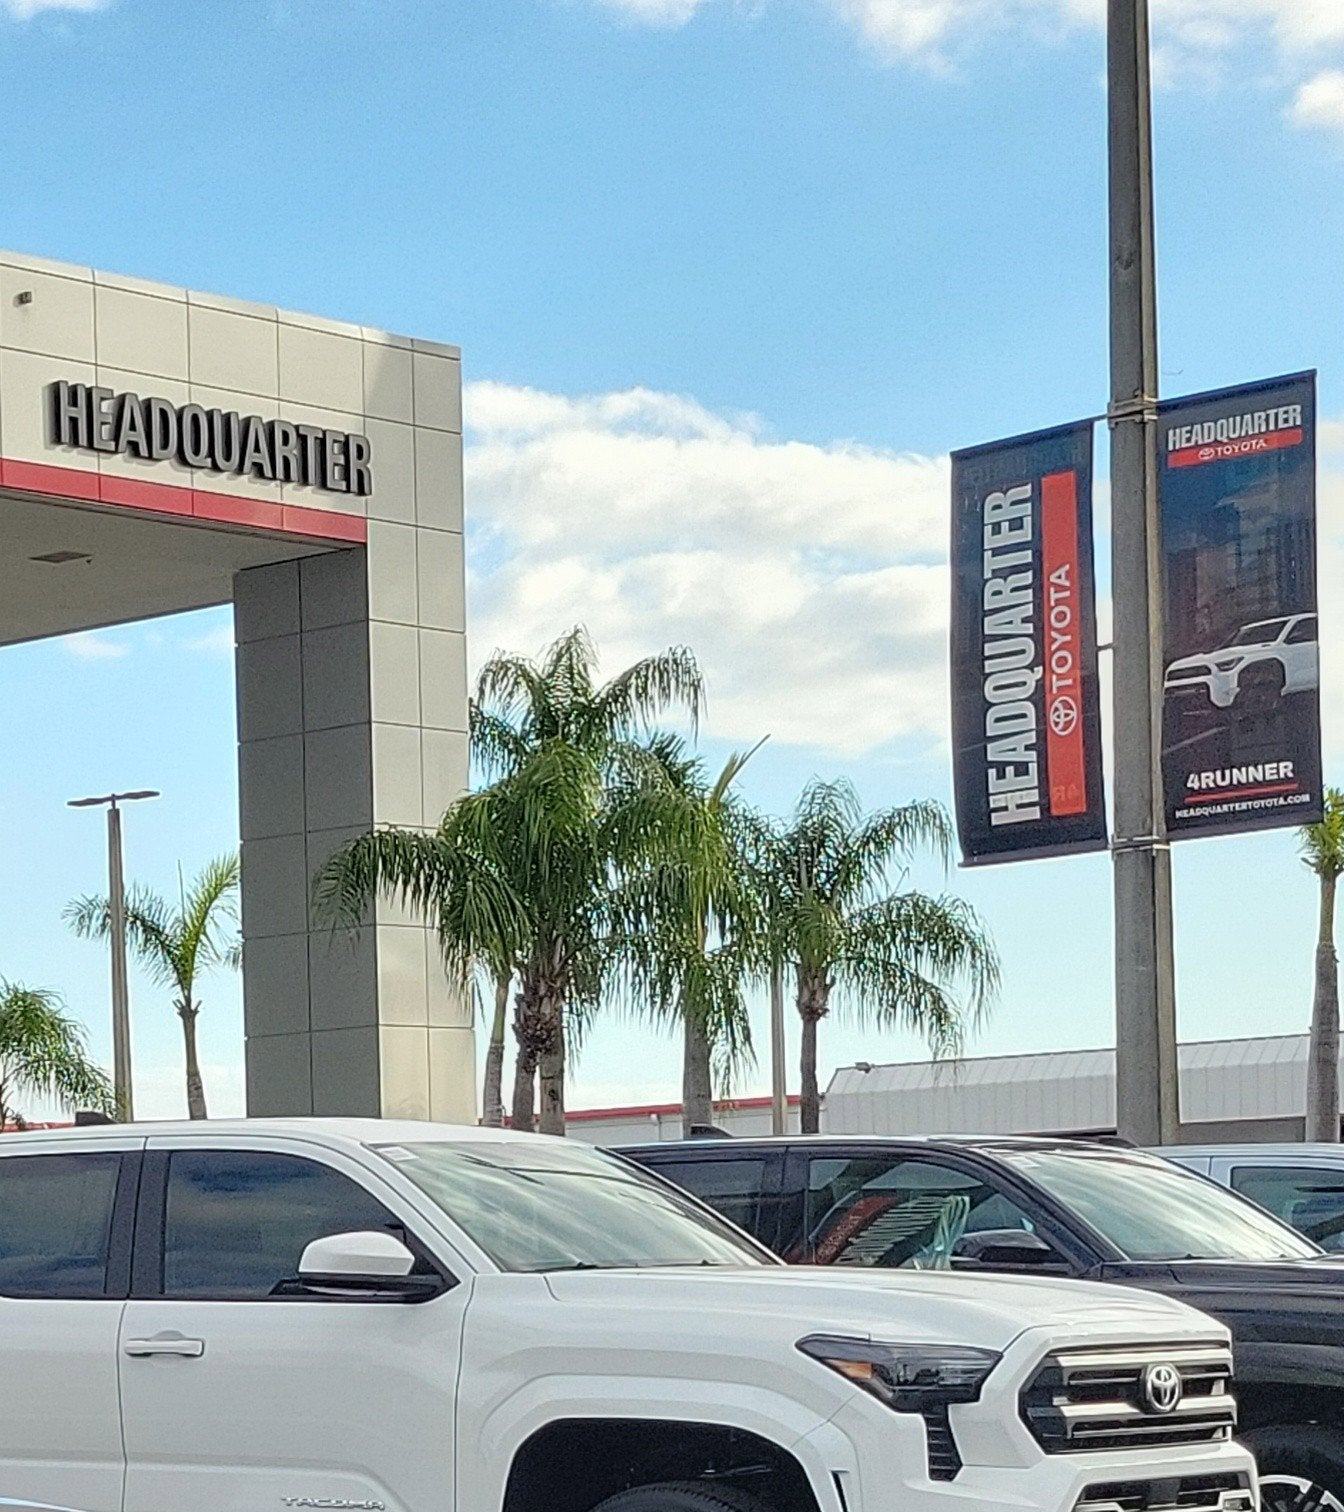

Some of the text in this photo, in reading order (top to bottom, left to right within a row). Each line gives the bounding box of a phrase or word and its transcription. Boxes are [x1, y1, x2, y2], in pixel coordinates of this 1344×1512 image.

[49, 379, 374, 496] HEADQUARTER
[1167, 404, 1302, 451] HEADQUARTER
[1216, 439, 1268, 457] TOYOTA
[1049, 562, 1075, 692] TOYOTA
[983, 481, 1043, 828] HEADQUARTER
[1186, 760, 1295, 791] 4RUNNER
[1174, 793, 1311, 820] HEADQUARTERTOYOTA.COM
[280, 1495, 386, 1511] TACOMA
